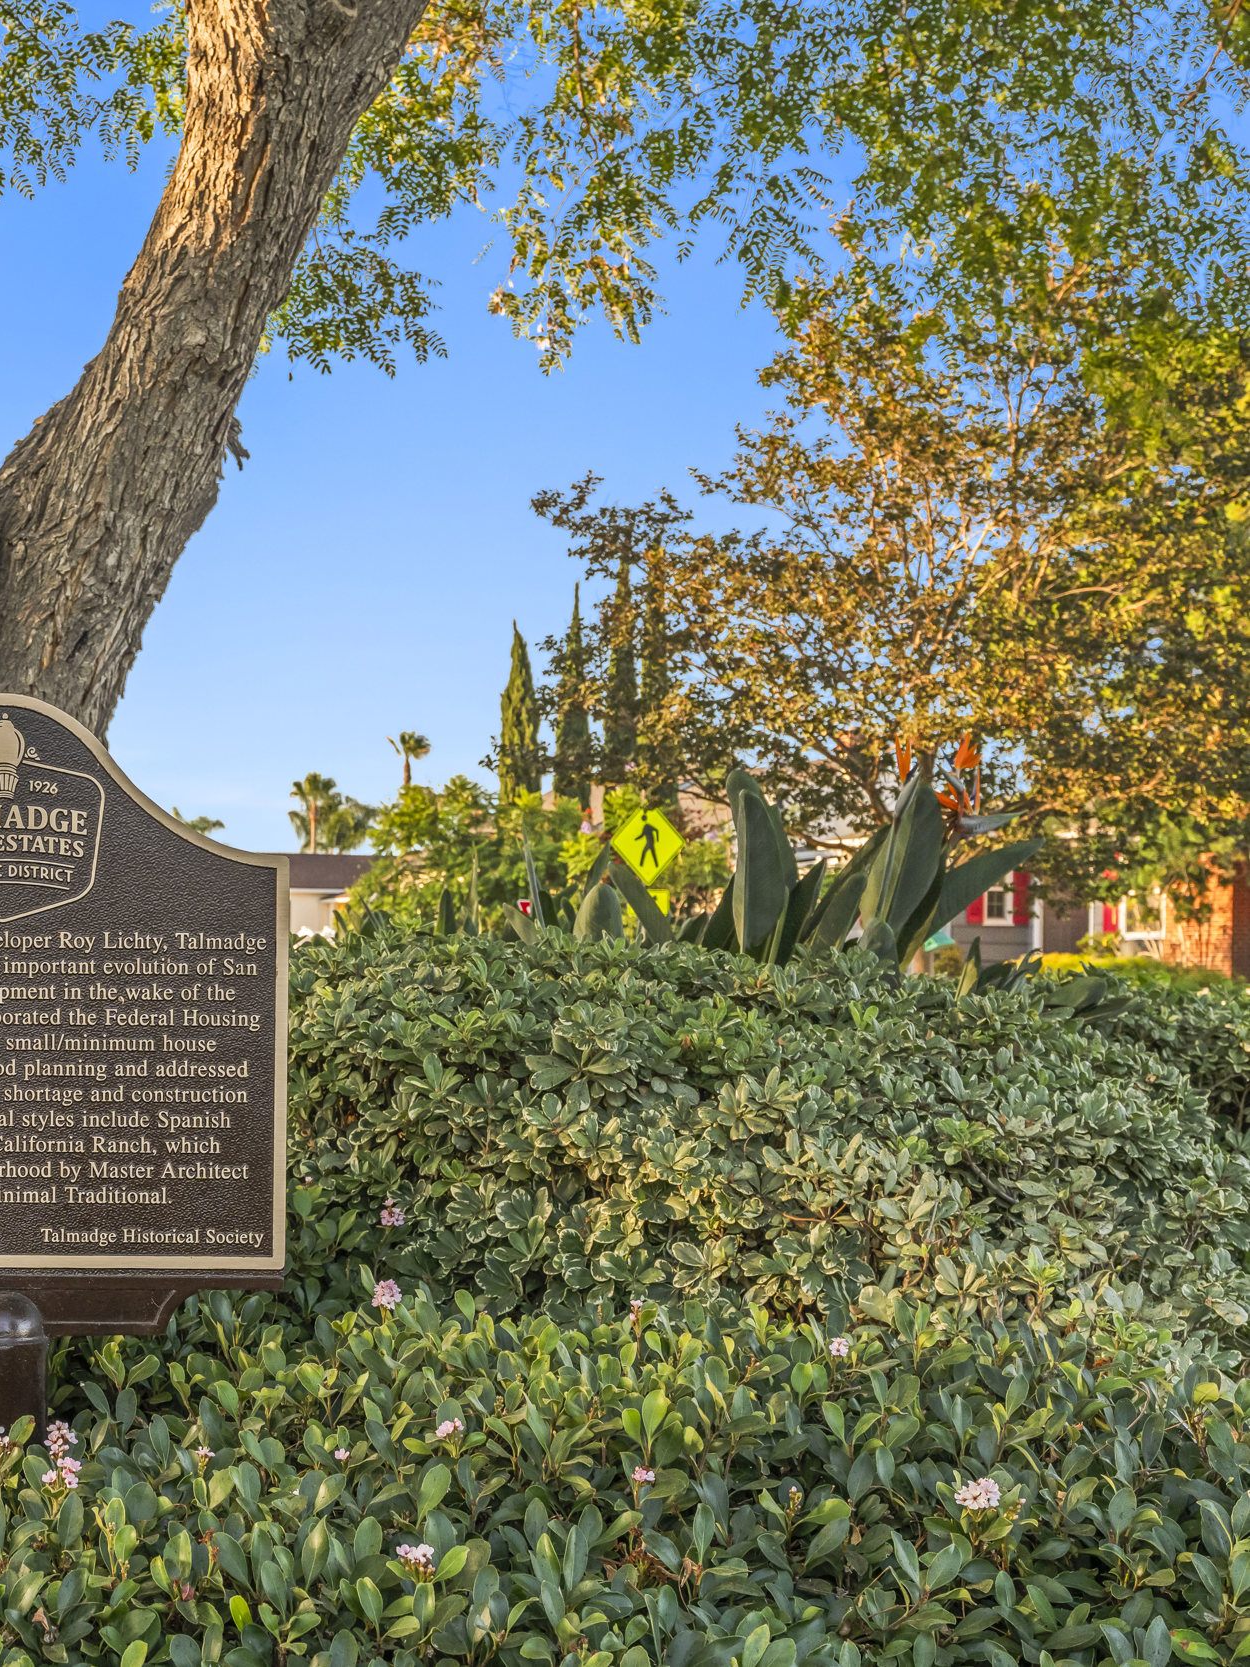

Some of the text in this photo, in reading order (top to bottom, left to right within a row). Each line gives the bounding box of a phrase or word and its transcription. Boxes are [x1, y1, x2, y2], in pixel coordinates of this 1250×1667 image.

[29, 780, 58, 795] 1926
[8, 865, 74, 883] DISTRICT
[59, 932, 95, 953] Roy
[103, 932, 168, 954] Lichty,
[175, 932, 267, 955] Talmadge
[4, 957, 95, 978] important
[103, 958, 189, 975] evolution
[196, 958, 217, 975] of
[223, 959, 257, 976] San
[64, 983, 81, 1000] in
[89, 983, 117, 1000] the
[126, 984, 173, 1000] wake
[181, 984, 201, 1000] of
[207, 984, 236, 1001] the
[68, 1008, 97, 1025] the
[105, 1009, 174, 1026] Federal
[182, 1009, 260, 1031] Housing
[6, 1034, 155, 1051] small/minimum
[162, 1035, 217, 1052] house
[24, 1060, 107, 1081] planning
[114, 1060, 148, 1077] and
[156, 1061, 249, 1078] addressed
[4, 1085, 83, 1106] shortage
[91, 1086, 124, 1102] and
[132, 1087, 247, 1103] construction
[22, 1110, 74, 1131] styles
[82, 1110, 150, 1128] include
[158, 1111, 231, 1132] Spanish
[92, 1136, 157, 1155] Ranch,
[165, 1137, 220, 1154] which
[60, 1162, 81, 1182] by
[89, 1162, 154, 1179] Master
[161, 1162, 249, 1180] Architect
[65, 1186, 173, 1204] Traditional.
[41, 1229, 264, 1247] Talmadge Historical Society
